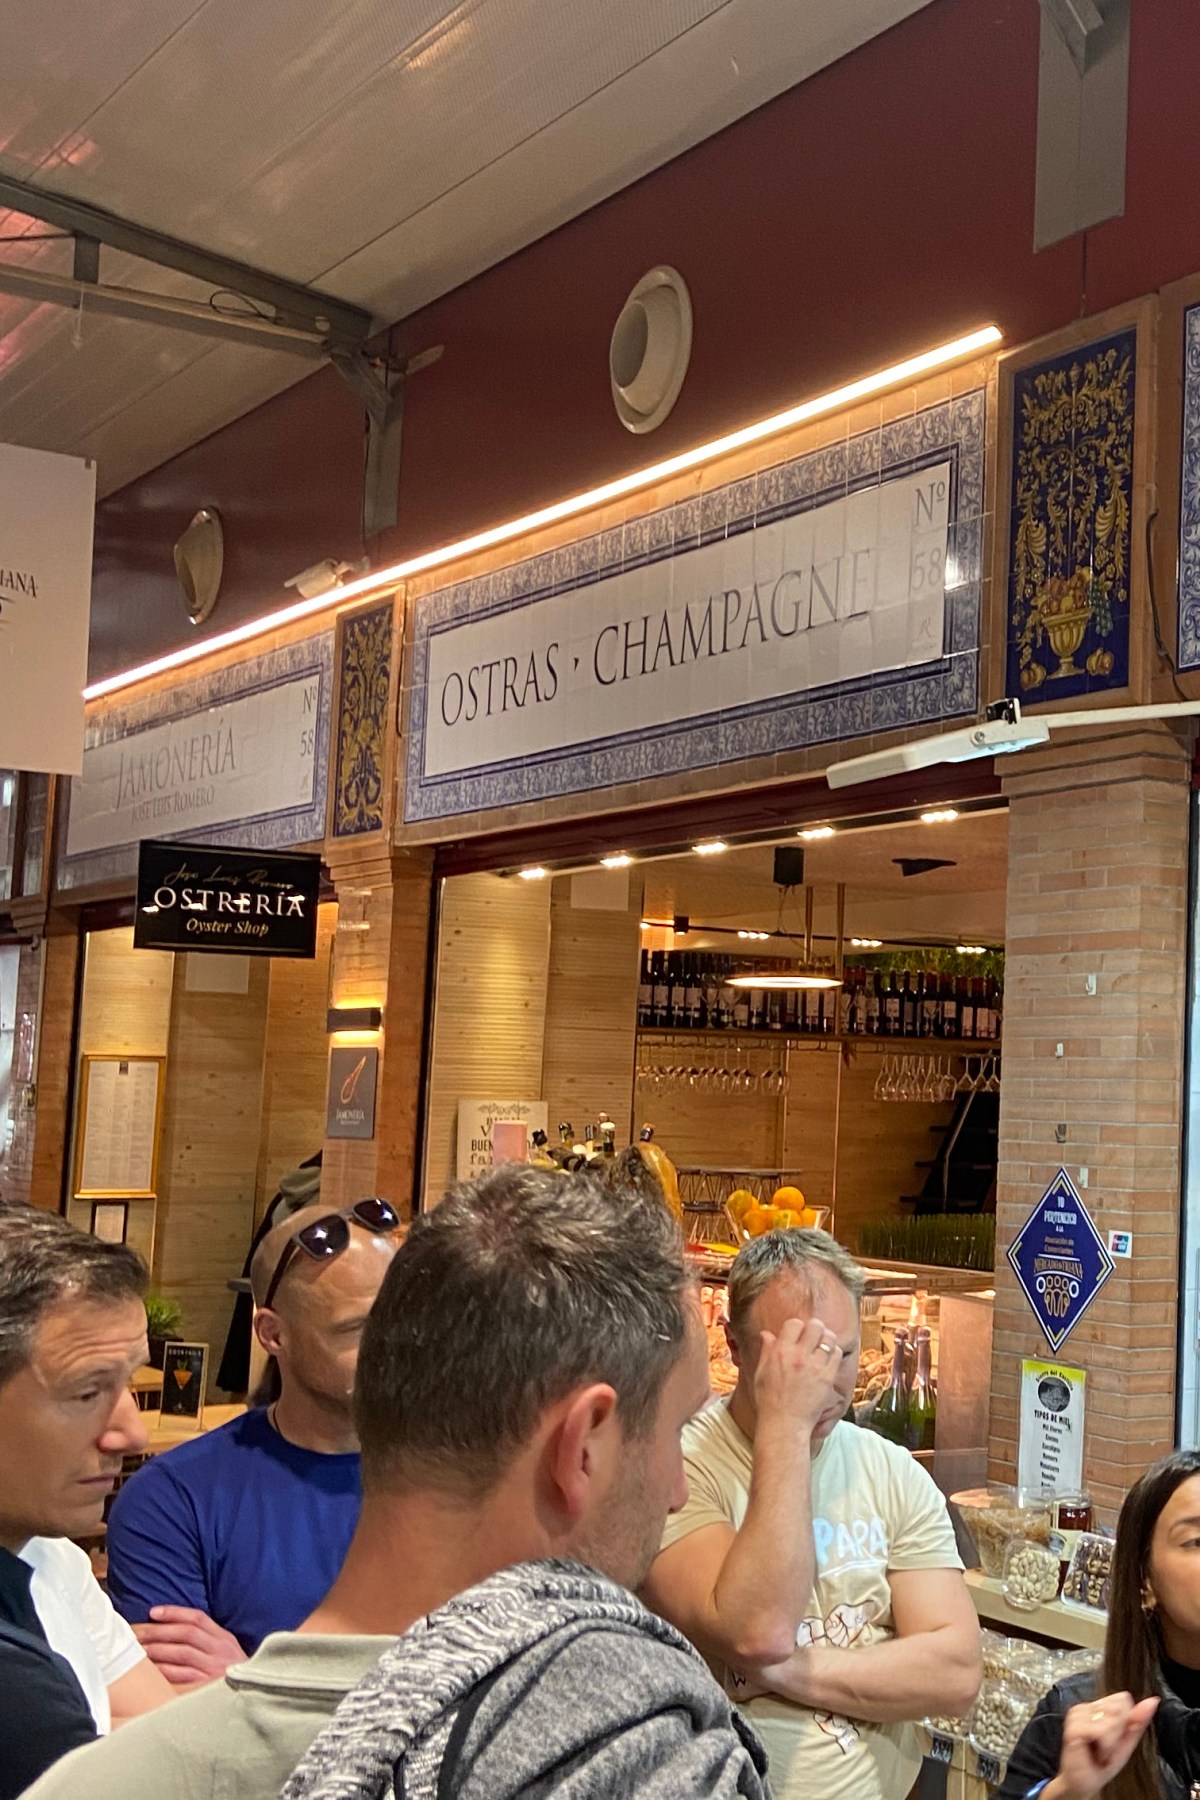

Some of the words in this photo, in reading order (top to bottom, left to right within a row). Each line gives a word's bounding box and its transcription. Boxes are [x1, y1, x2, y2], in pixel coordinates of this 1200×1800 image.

[912, 548, 942, 591] 58
[441, 642, 560, 727] OSTRAS
[593, 547, 872, 686] CHAMPAGNE
[300, 728, 314, 757] 58
[117, 718, 236, 809] JAMONERÍA
[174, 785, 215, 812] ROMERO
[154, 886, 305, 918] OSTRERÍA
[186, 918, 233, 935] Oyster
[234, 921, 269, 938] Shop
[1034, 1409, 1049, 1421] TIPOS
